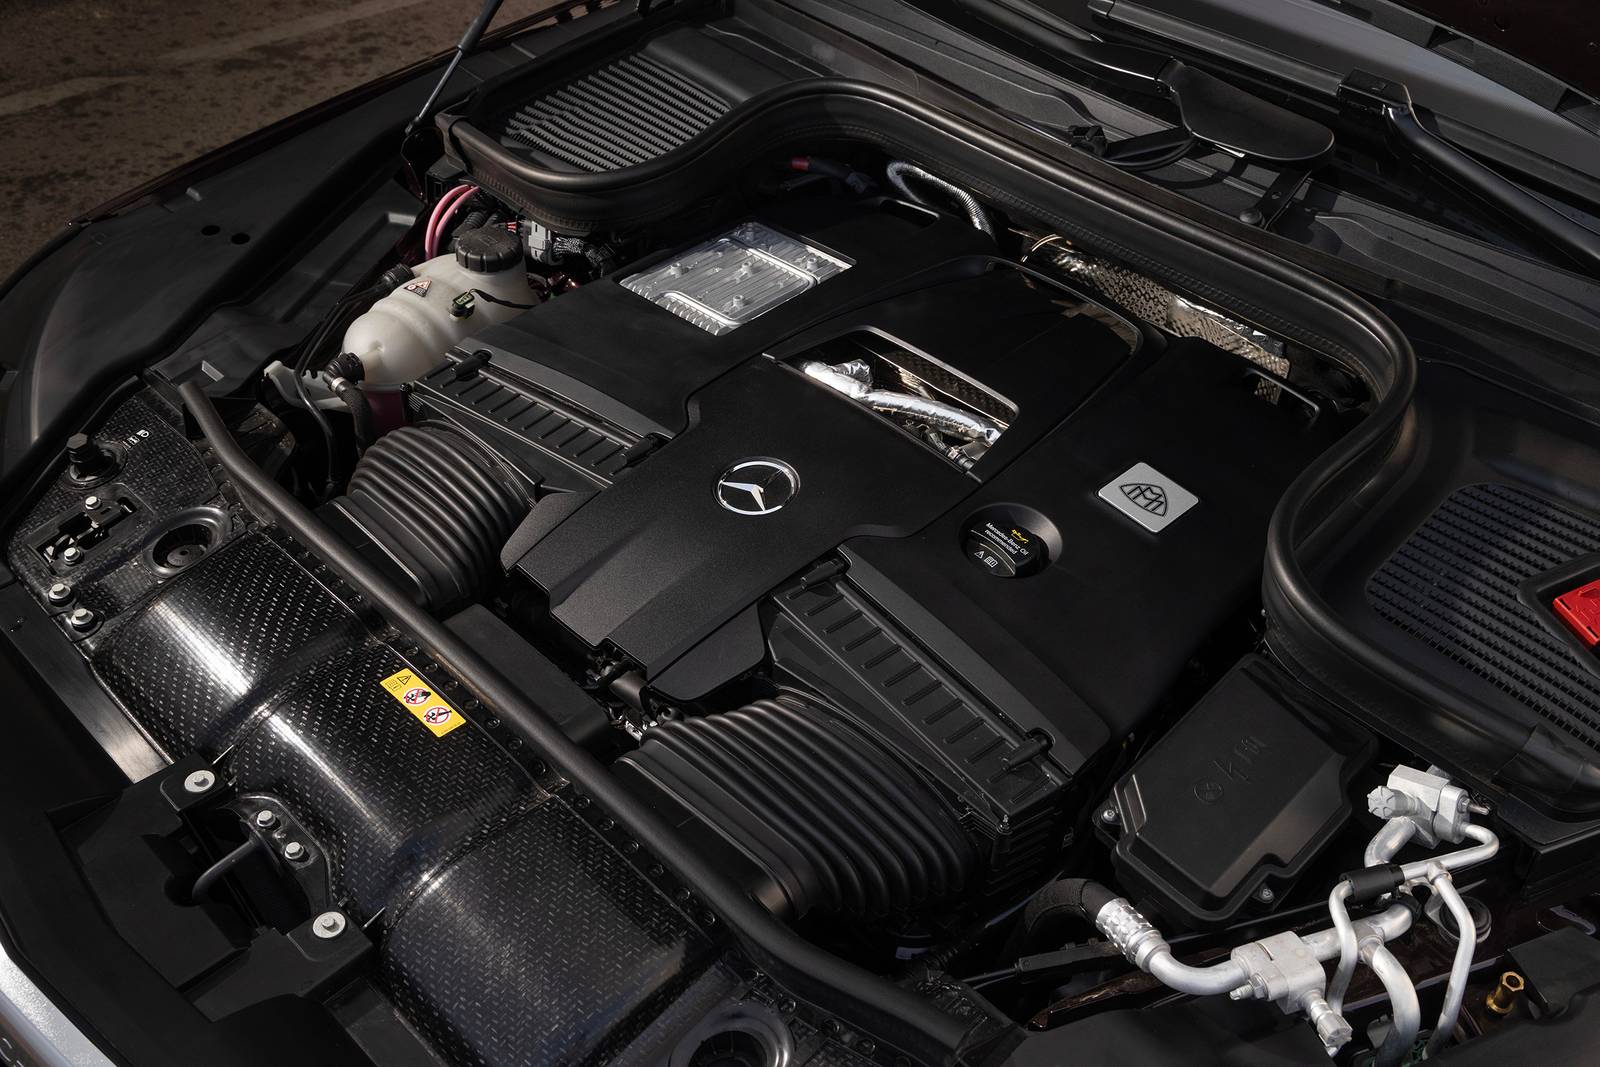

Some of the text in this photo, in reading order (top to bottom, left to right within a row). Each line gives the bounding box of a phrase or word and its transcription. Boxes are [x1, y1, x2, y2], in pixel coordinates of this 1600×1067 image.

[984, 529, 1018, 555] recommended
[985, 522, 1030, 556] Mercedes-Benz Oil
